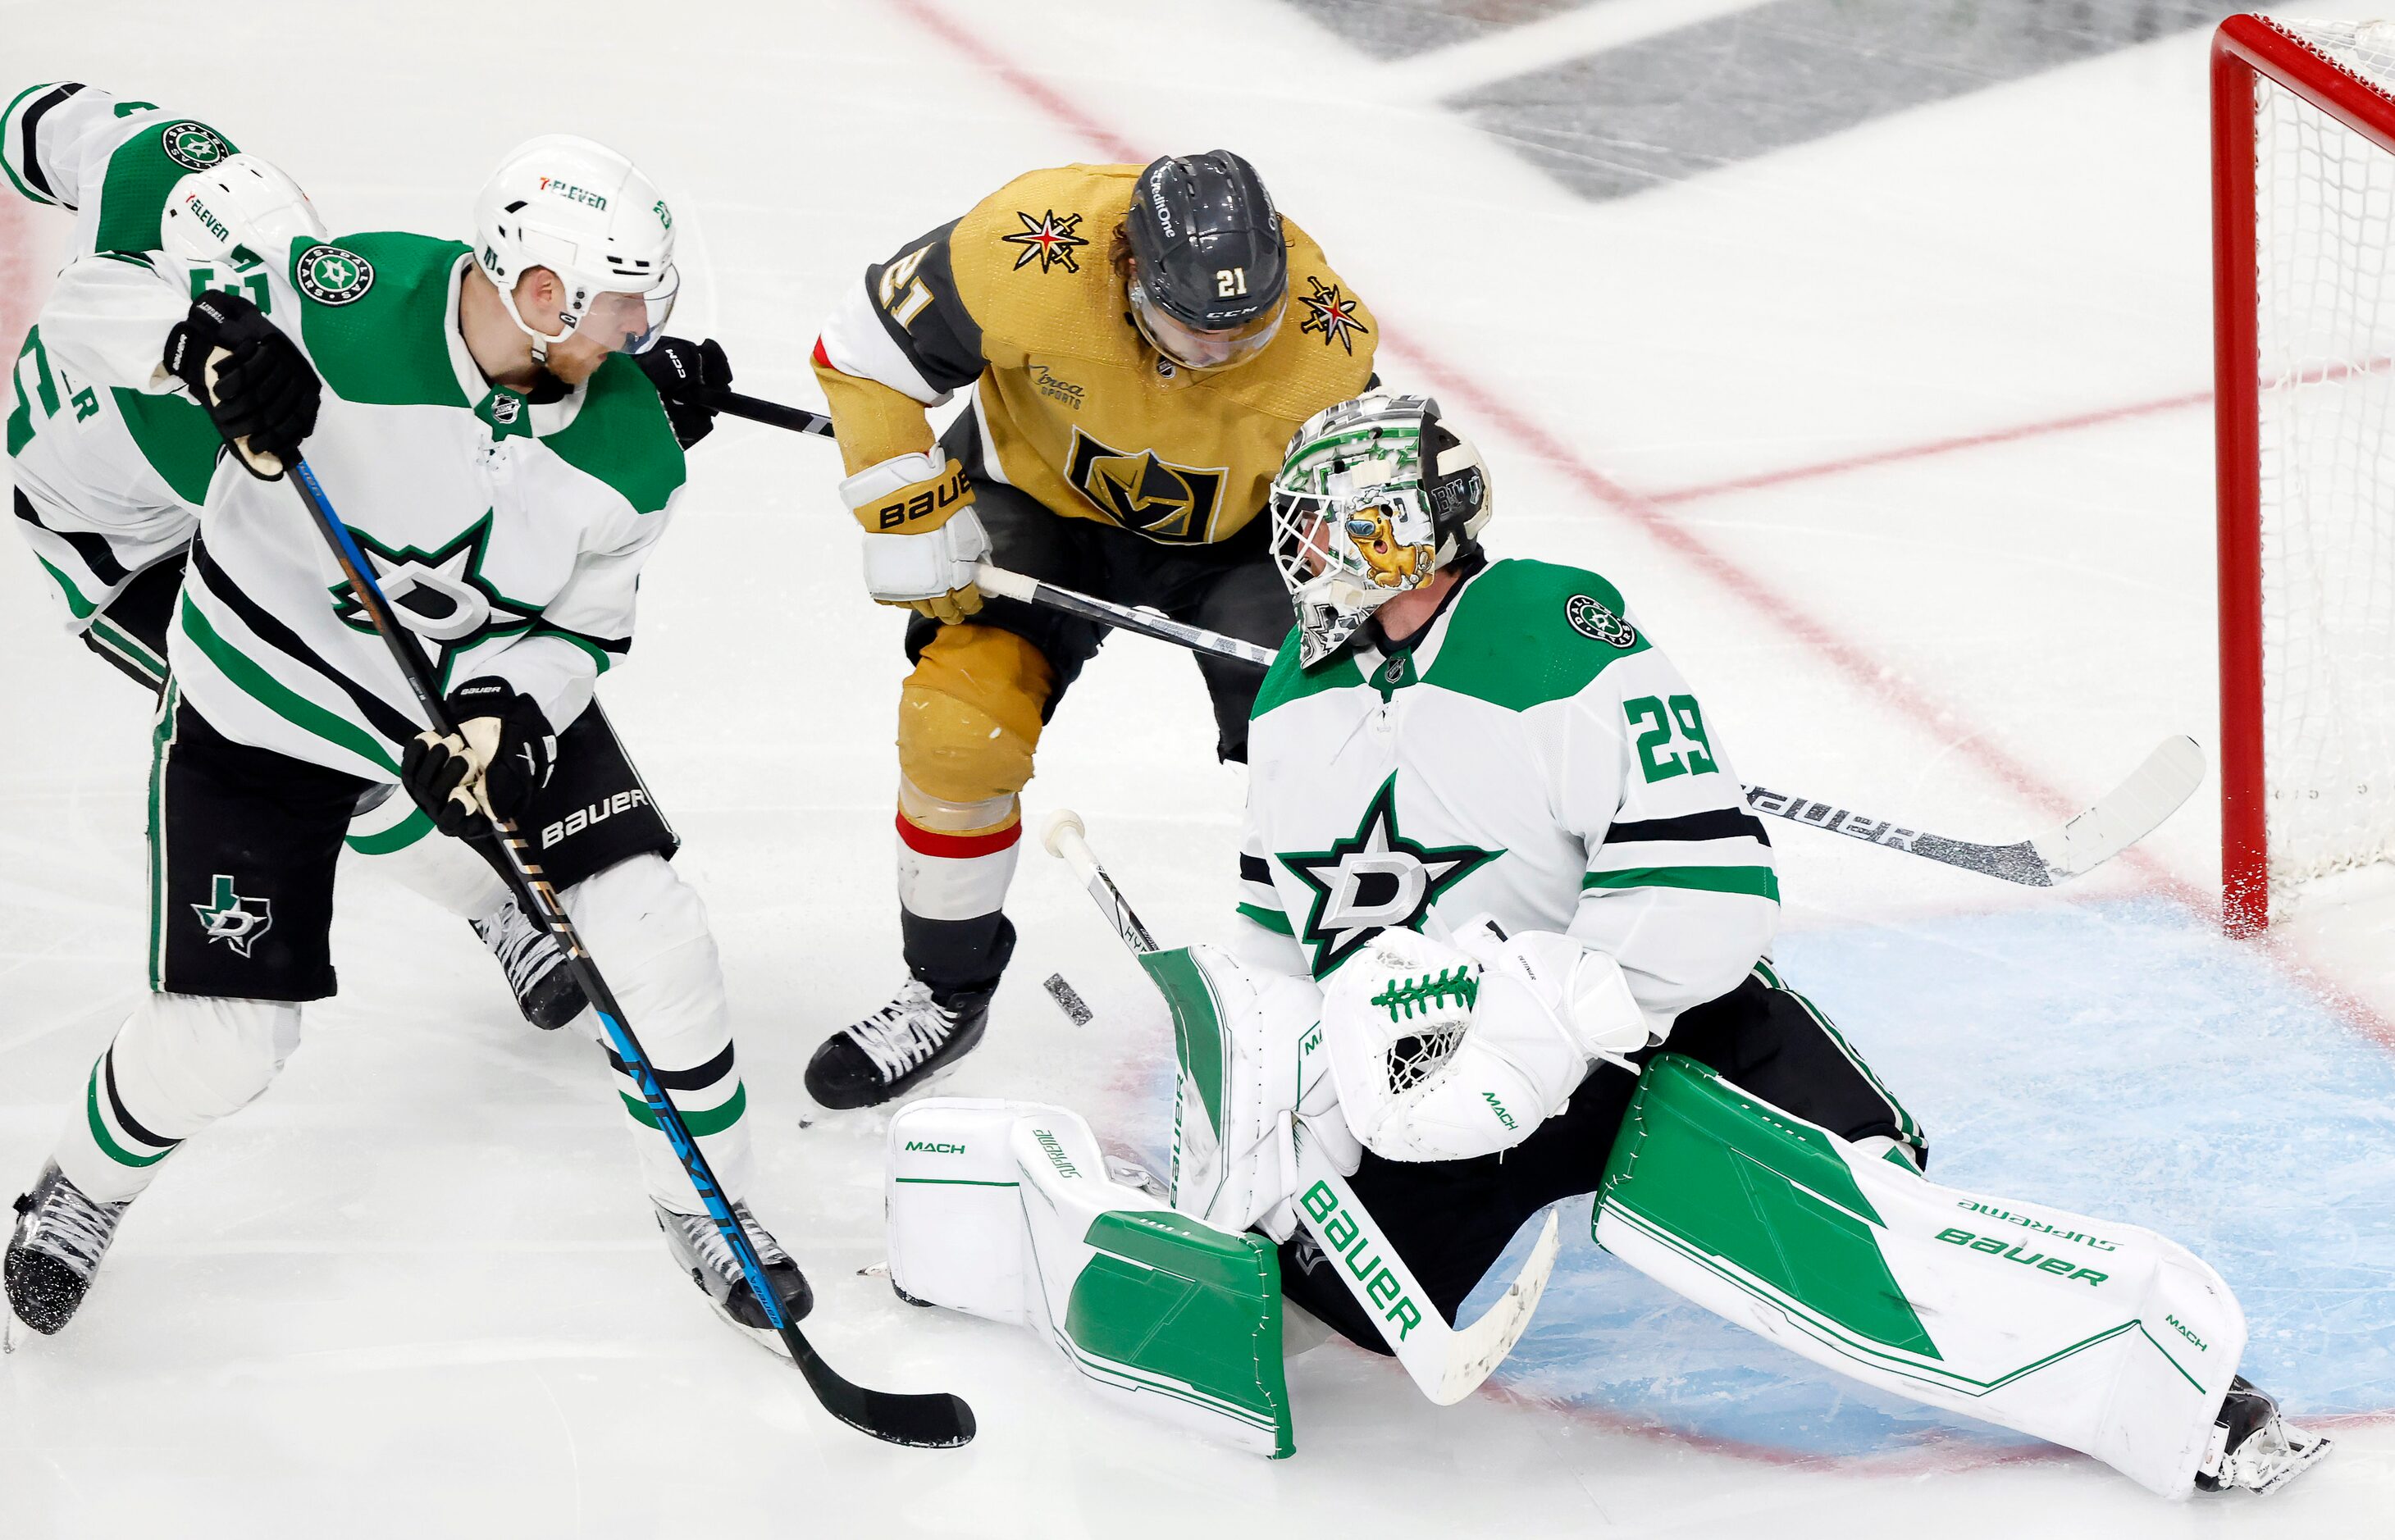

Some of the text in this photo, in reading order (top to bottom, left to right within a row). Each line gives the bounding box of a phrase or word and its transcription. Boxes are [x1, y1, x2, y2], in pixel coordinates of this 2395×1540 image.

[879, 242, 937, 335] 21
[1216, 267, 1248, 298] 21
[1206, 305, 1258, 319] CCM
[665, 349, 687, 379] CCM
[1040, 385, 1083, 411] SPORTS
[1623, 694, 1720, 785] 29
[1740, 784, 1924, 852] AUER
[493, 817, 591, 961] UER
[1481, 1091, 1519, 1132] MACH
[905, 1141, 966, 1155] MACH
[1300, 1179, 1422, 1342] BAUER
[1934, 1228, 2110, 1287] BAUER
[2165, 1314, 2208, 1353] MACH
